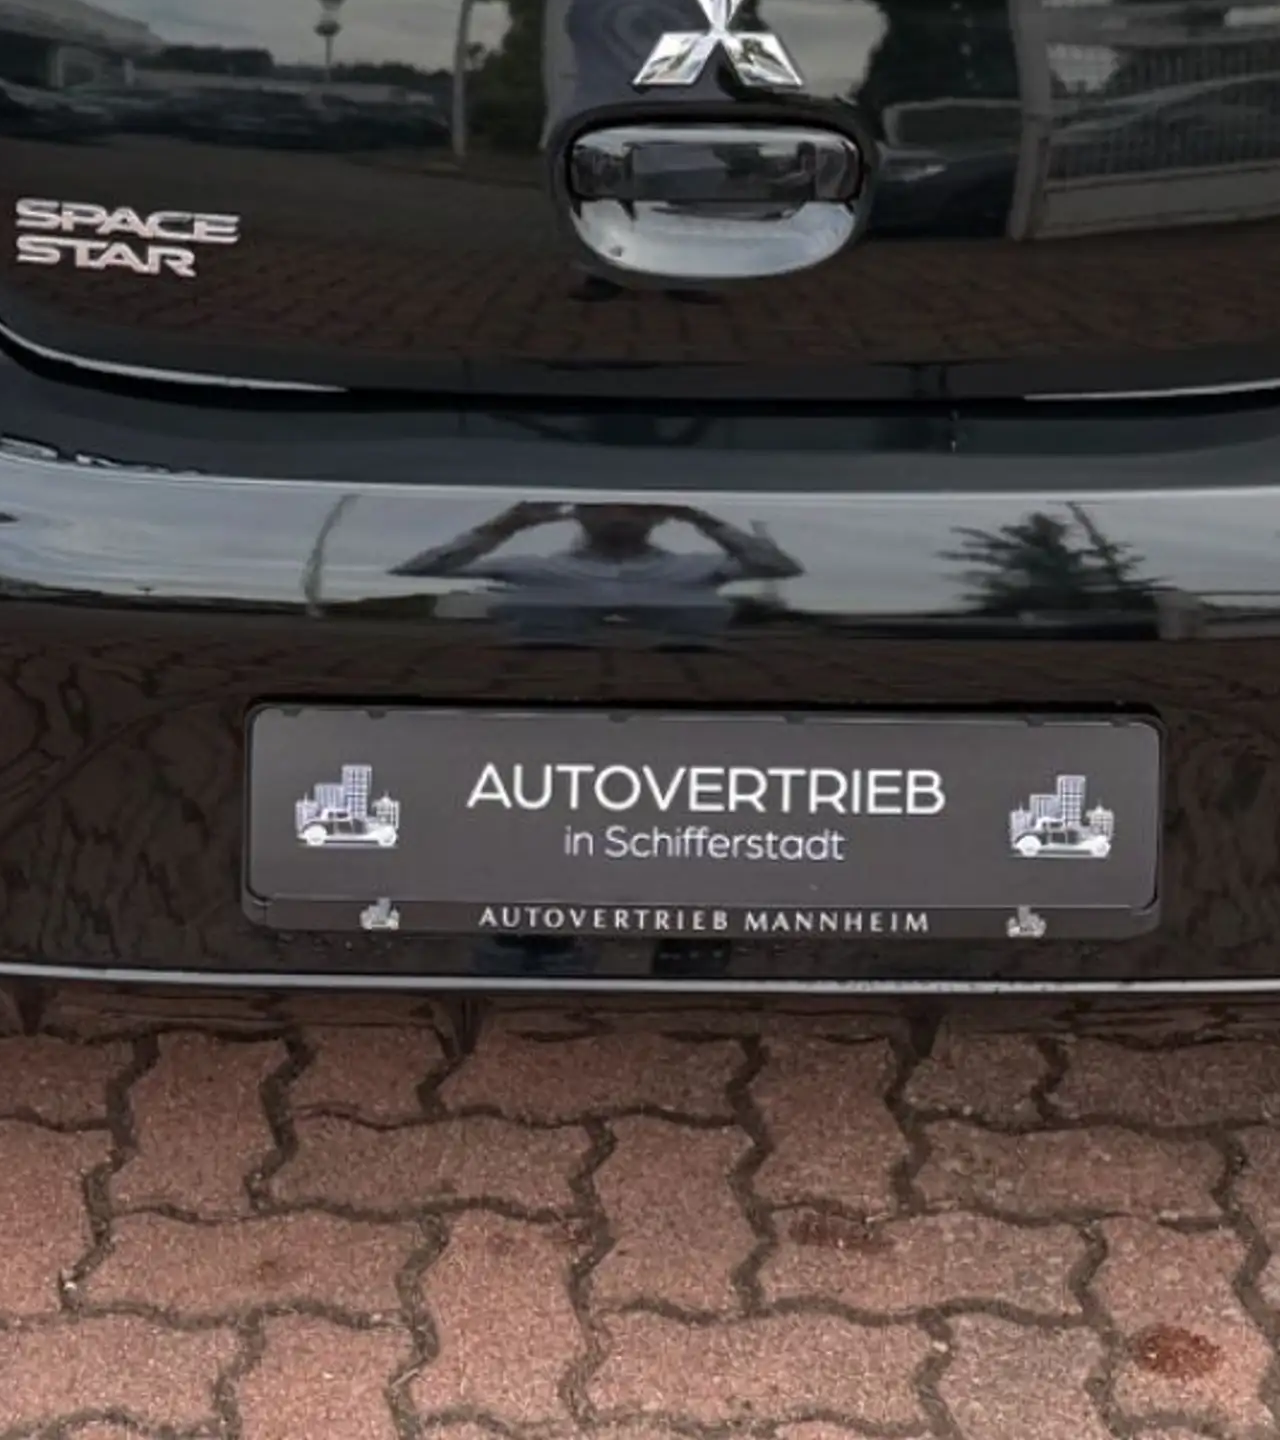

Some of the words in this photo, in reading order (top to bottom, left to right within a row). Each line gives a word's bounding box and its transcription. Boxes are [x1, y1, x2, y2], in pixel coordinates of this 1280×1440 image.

[15, 197, 241, 244] SPACE
[16, 234, 197, 277] STAR
[466, 763, 947, 815] AUTOVERTRIEB
[563, 825, 594, 856] in
[604, 825, 846, 861] Schifferstadt
[478, 906, 729, 931] AUTOVERTRIEB
[743, 910, 930, 933] MANNHEIM
